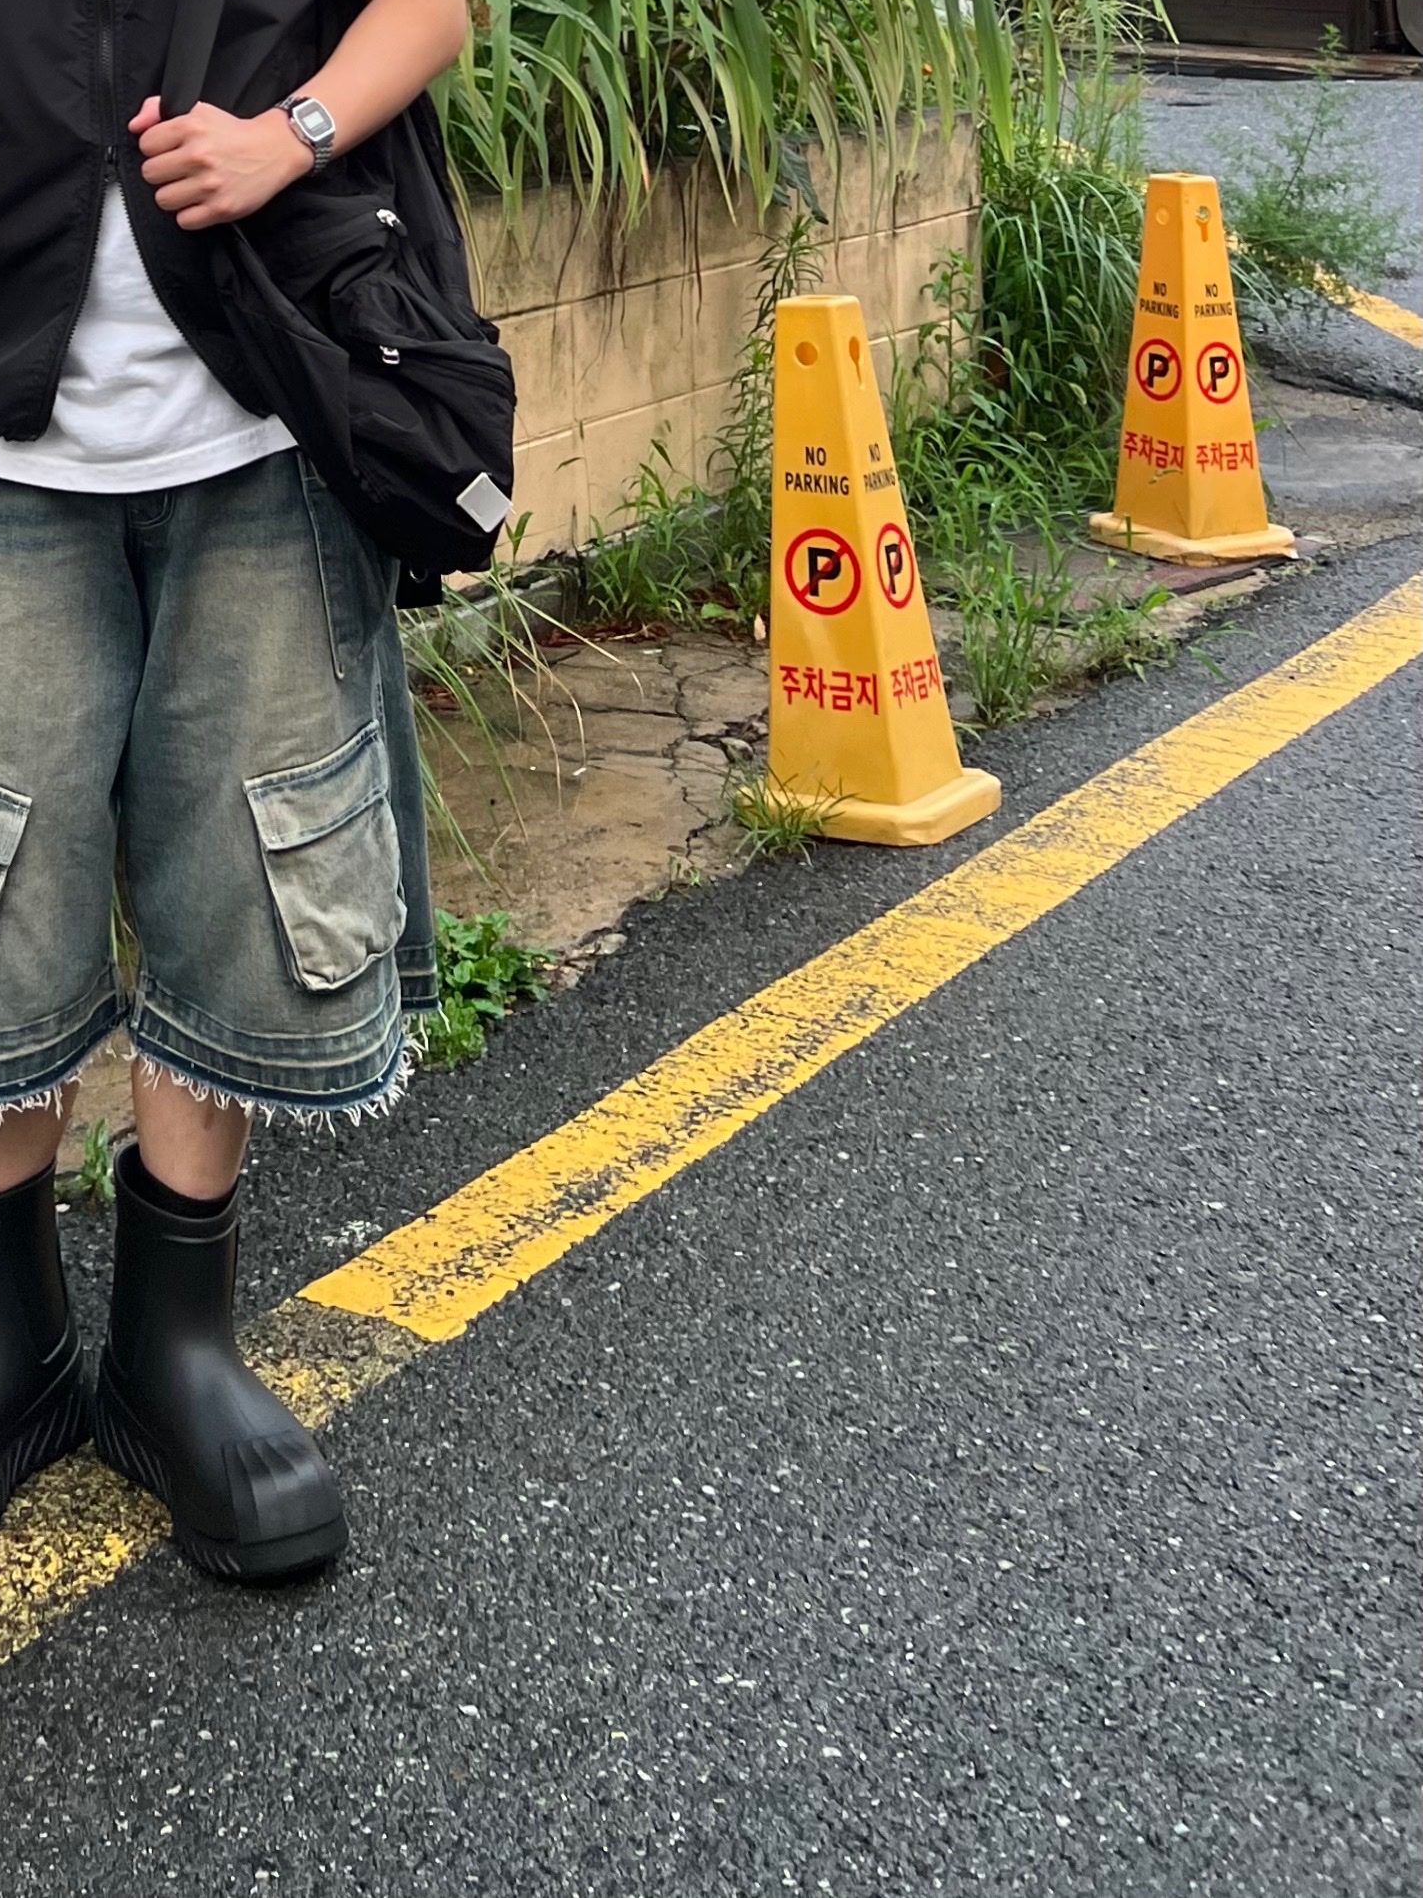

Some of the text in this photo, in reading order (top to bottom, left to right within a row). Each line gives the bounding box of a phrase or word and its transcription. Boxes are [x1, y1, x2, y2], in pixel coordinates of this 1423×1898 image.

[1153, 281, 1167, 297] NO
[1205, 283, 1218, 297] NO
[1139, 298, 1179, 319] PARKING
[1194, 302, 1233, 318] PARKING
[805, 446, 826, 466] NO
[869, 443, 881, 463] NO
[1123, 430, 1185, 470] 주차금지
[1196, 440, 1254, 473] 주차금지
[785, 472, 849, 495] PARKING
[863, 467, 896, 493] PARKING
[779, 664, 879, 715] 주차금지
[890, 653, 942, 709] 주차금지
